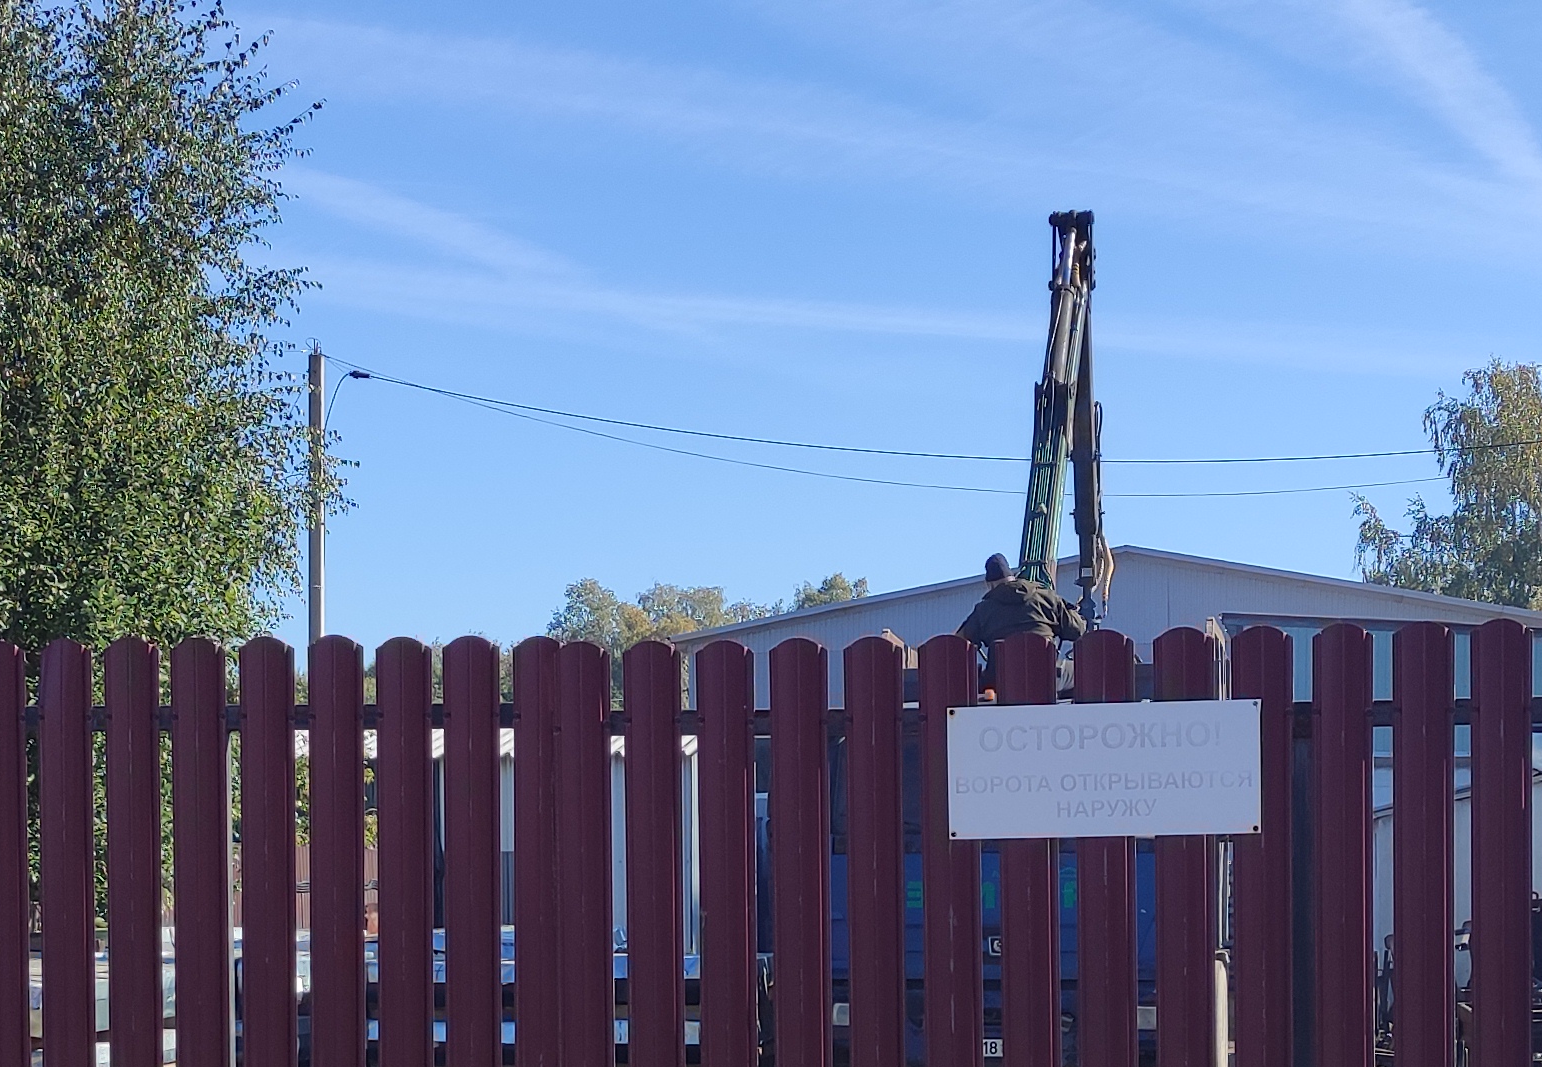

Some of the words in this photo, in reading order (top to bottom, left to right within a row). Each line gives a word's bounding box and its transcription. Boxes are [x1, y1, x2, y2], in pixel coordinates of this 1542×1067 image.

[978, 721, 1221, 752] ОСТОРОЖНО!
[955, 774, 1052, 794] ВОРОТА
[1060, 770, 1253, 792] ОТКРЫВАЮТСЯ
[1056, 798, 1157, 818] НАРУЖУ
